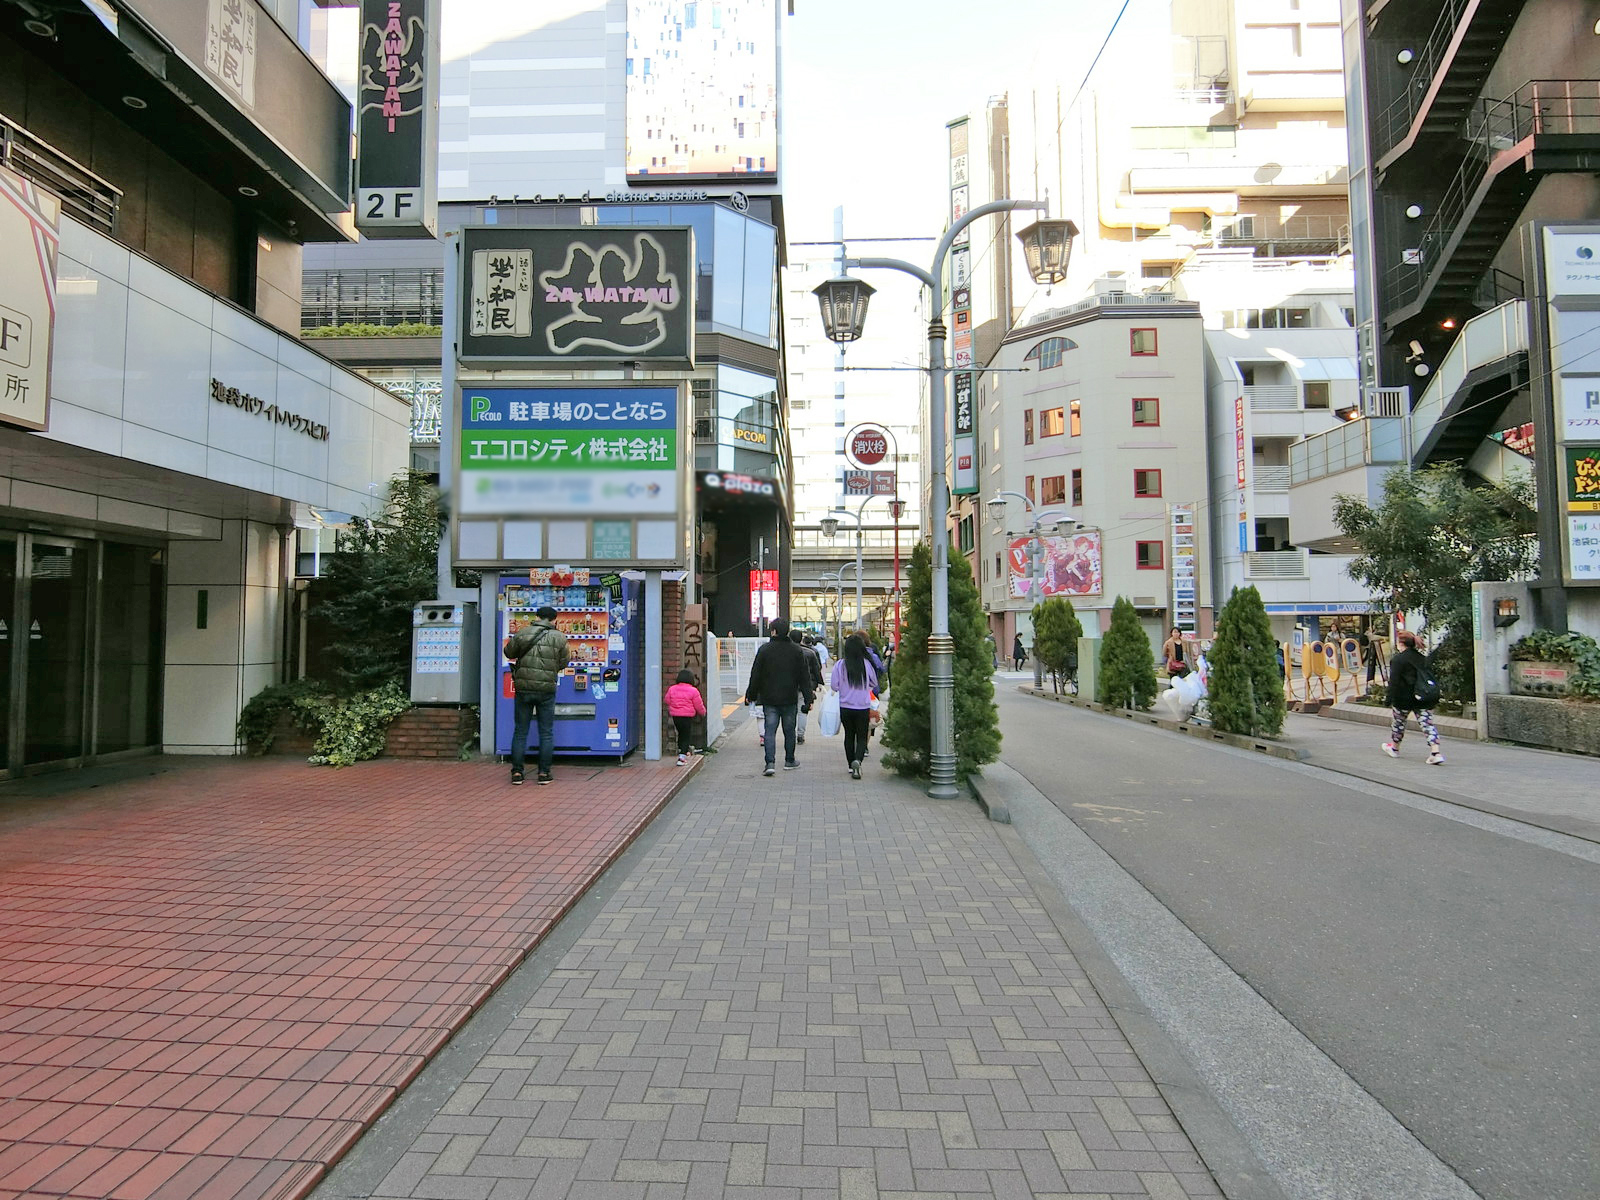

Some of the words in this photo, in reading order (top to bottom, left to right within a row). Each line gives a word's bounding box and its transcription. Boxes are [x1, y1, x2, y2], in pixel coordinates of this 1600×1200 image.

[366, 193, 414, 219] 2F
[604, 190, 651, 203] cinema
[652, 187, 709, 203] sunshine
[475, 298, 485, 328] わたみ
[4, 373, 30, 404] 所
[211, 377, 330, 441] 池袋ホワイトハウスビル
[509, 401, 668, 422] 駐車場のことなら
[956, 388, 971, 430] 甘太郎
[469, 437, 668, 462] エコロシティ株式会社
[854, 439, 886, 455] 消火栓
[1574, 476, 1600, 494] ドン
[1590, 523, 1600, 531] 人
[1572, 537, 1600, 546] 池袋ロ
